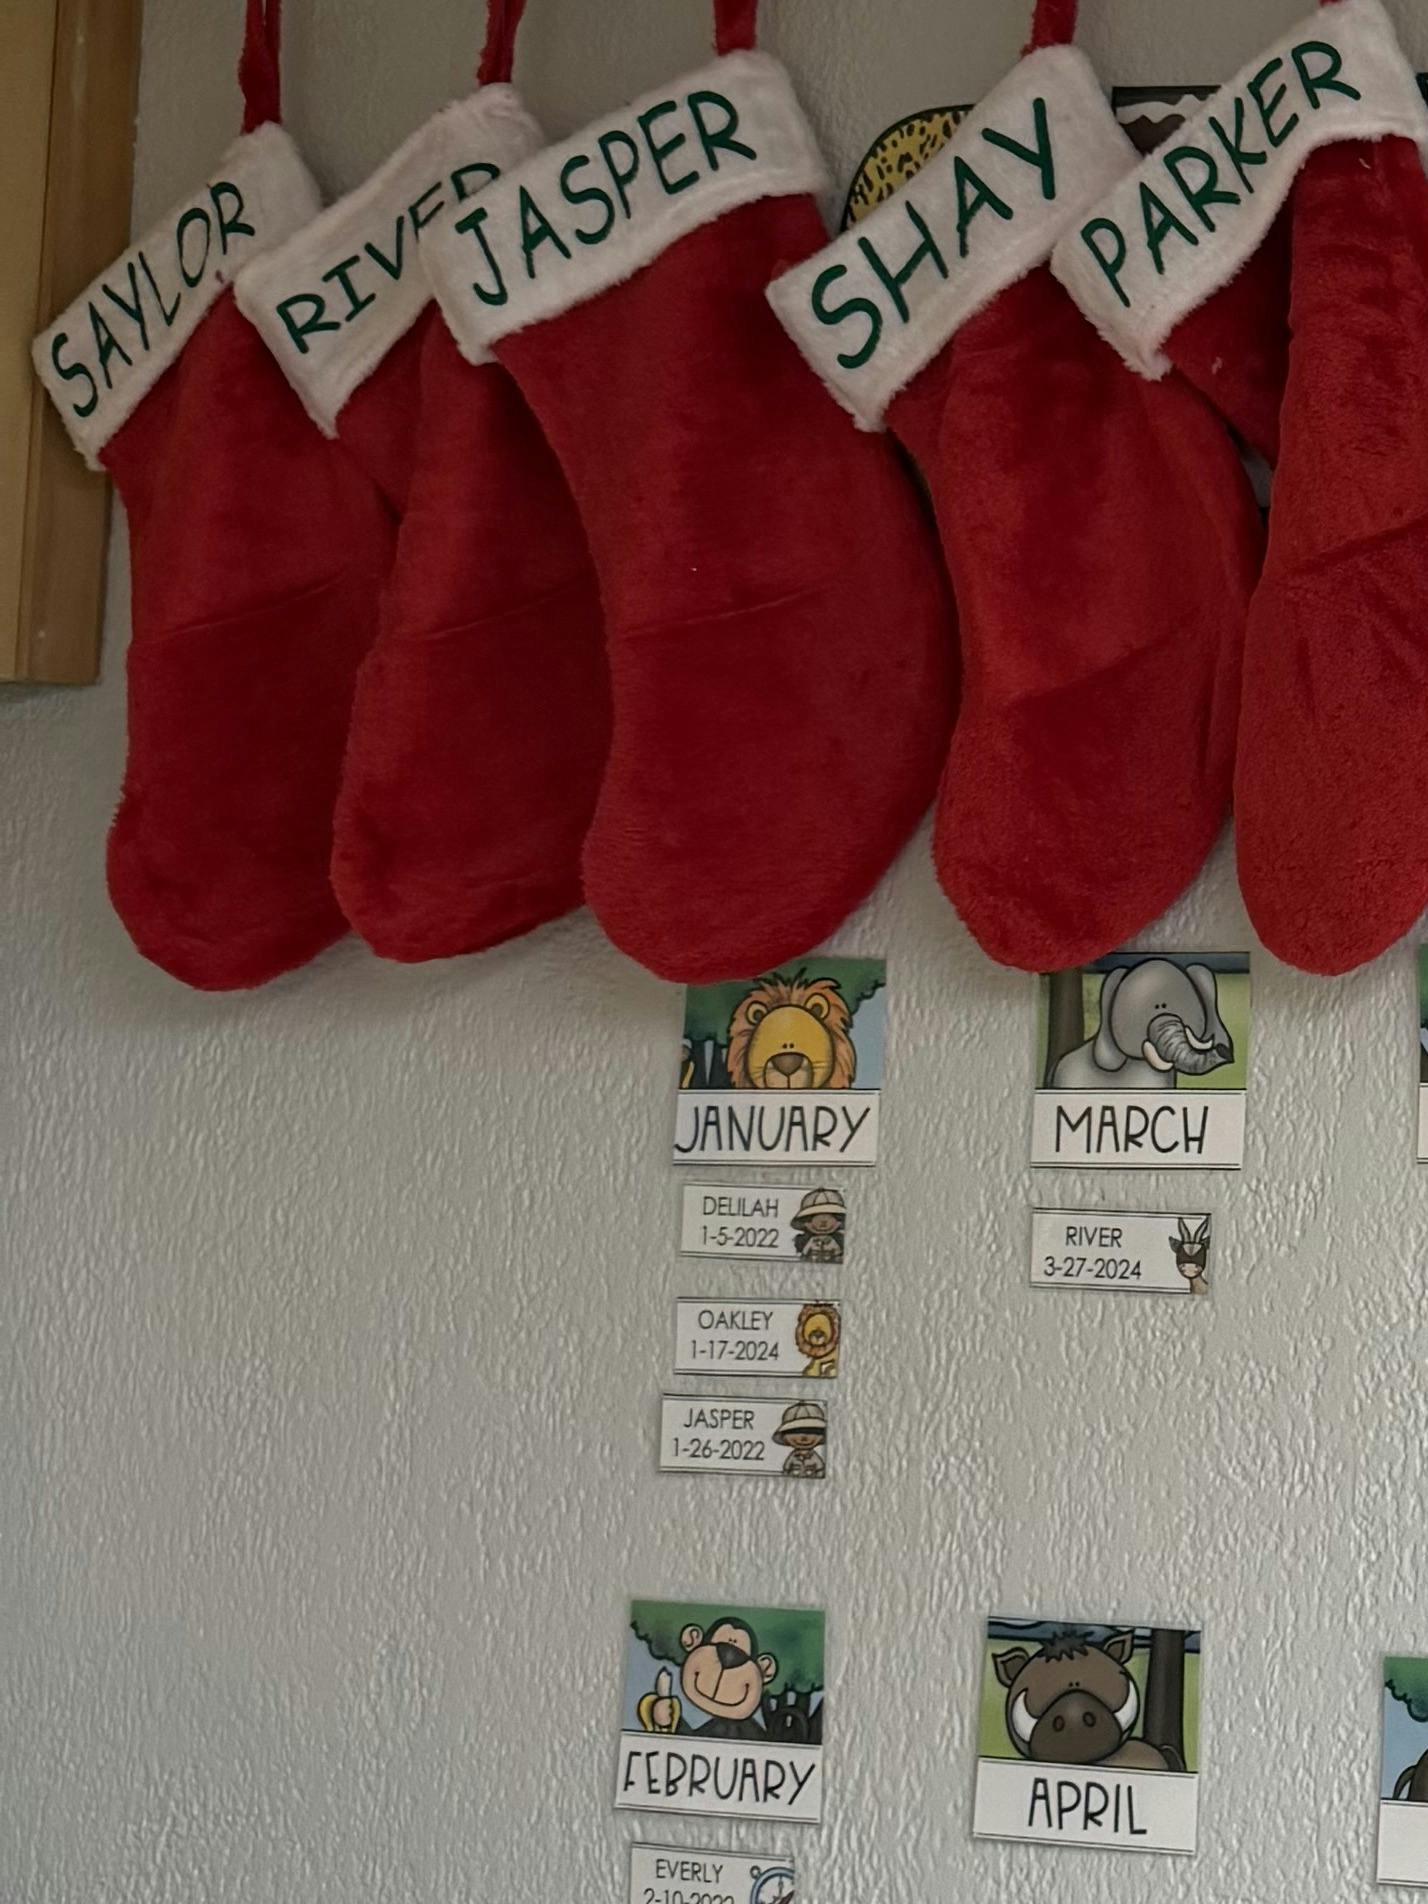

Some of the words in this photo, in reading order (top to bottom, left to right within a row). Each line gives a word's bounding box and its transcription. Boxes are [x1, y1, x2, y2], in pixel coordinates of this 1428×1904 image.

[1080, 40, 1363, 308] PARKER
[453, 90, 758, 308] JASPER
[811, 96, 1058, 370] SHAY
[51, 180, 257, 419] SAYLOR
[672, 1106, 870, 1153] JANUARY
[1056, 1106, 1208, 1154] MARCH
[703, 1196, 778, 1217] DELILAH
[703, 1226, 779, 1248] 1-5-2022
[1066, 1226, 1122, 1248] RIVER
[1044, 1256, 1141, 1279] 3-27-2024
[698, 1310, 773, 1330] OAKLEY
[692, 1340, 778, 1360] 1-17-2024
[684, 1408, 754, 1429] JASPER
[674, 1438, 764, 1460] 1-26-2022
[623, 1751, 815, 1807] FEBRUARY
[1028, 1778, 1147, 1834] APRIL
[656, 1859, 723, 1883] EVERLY
